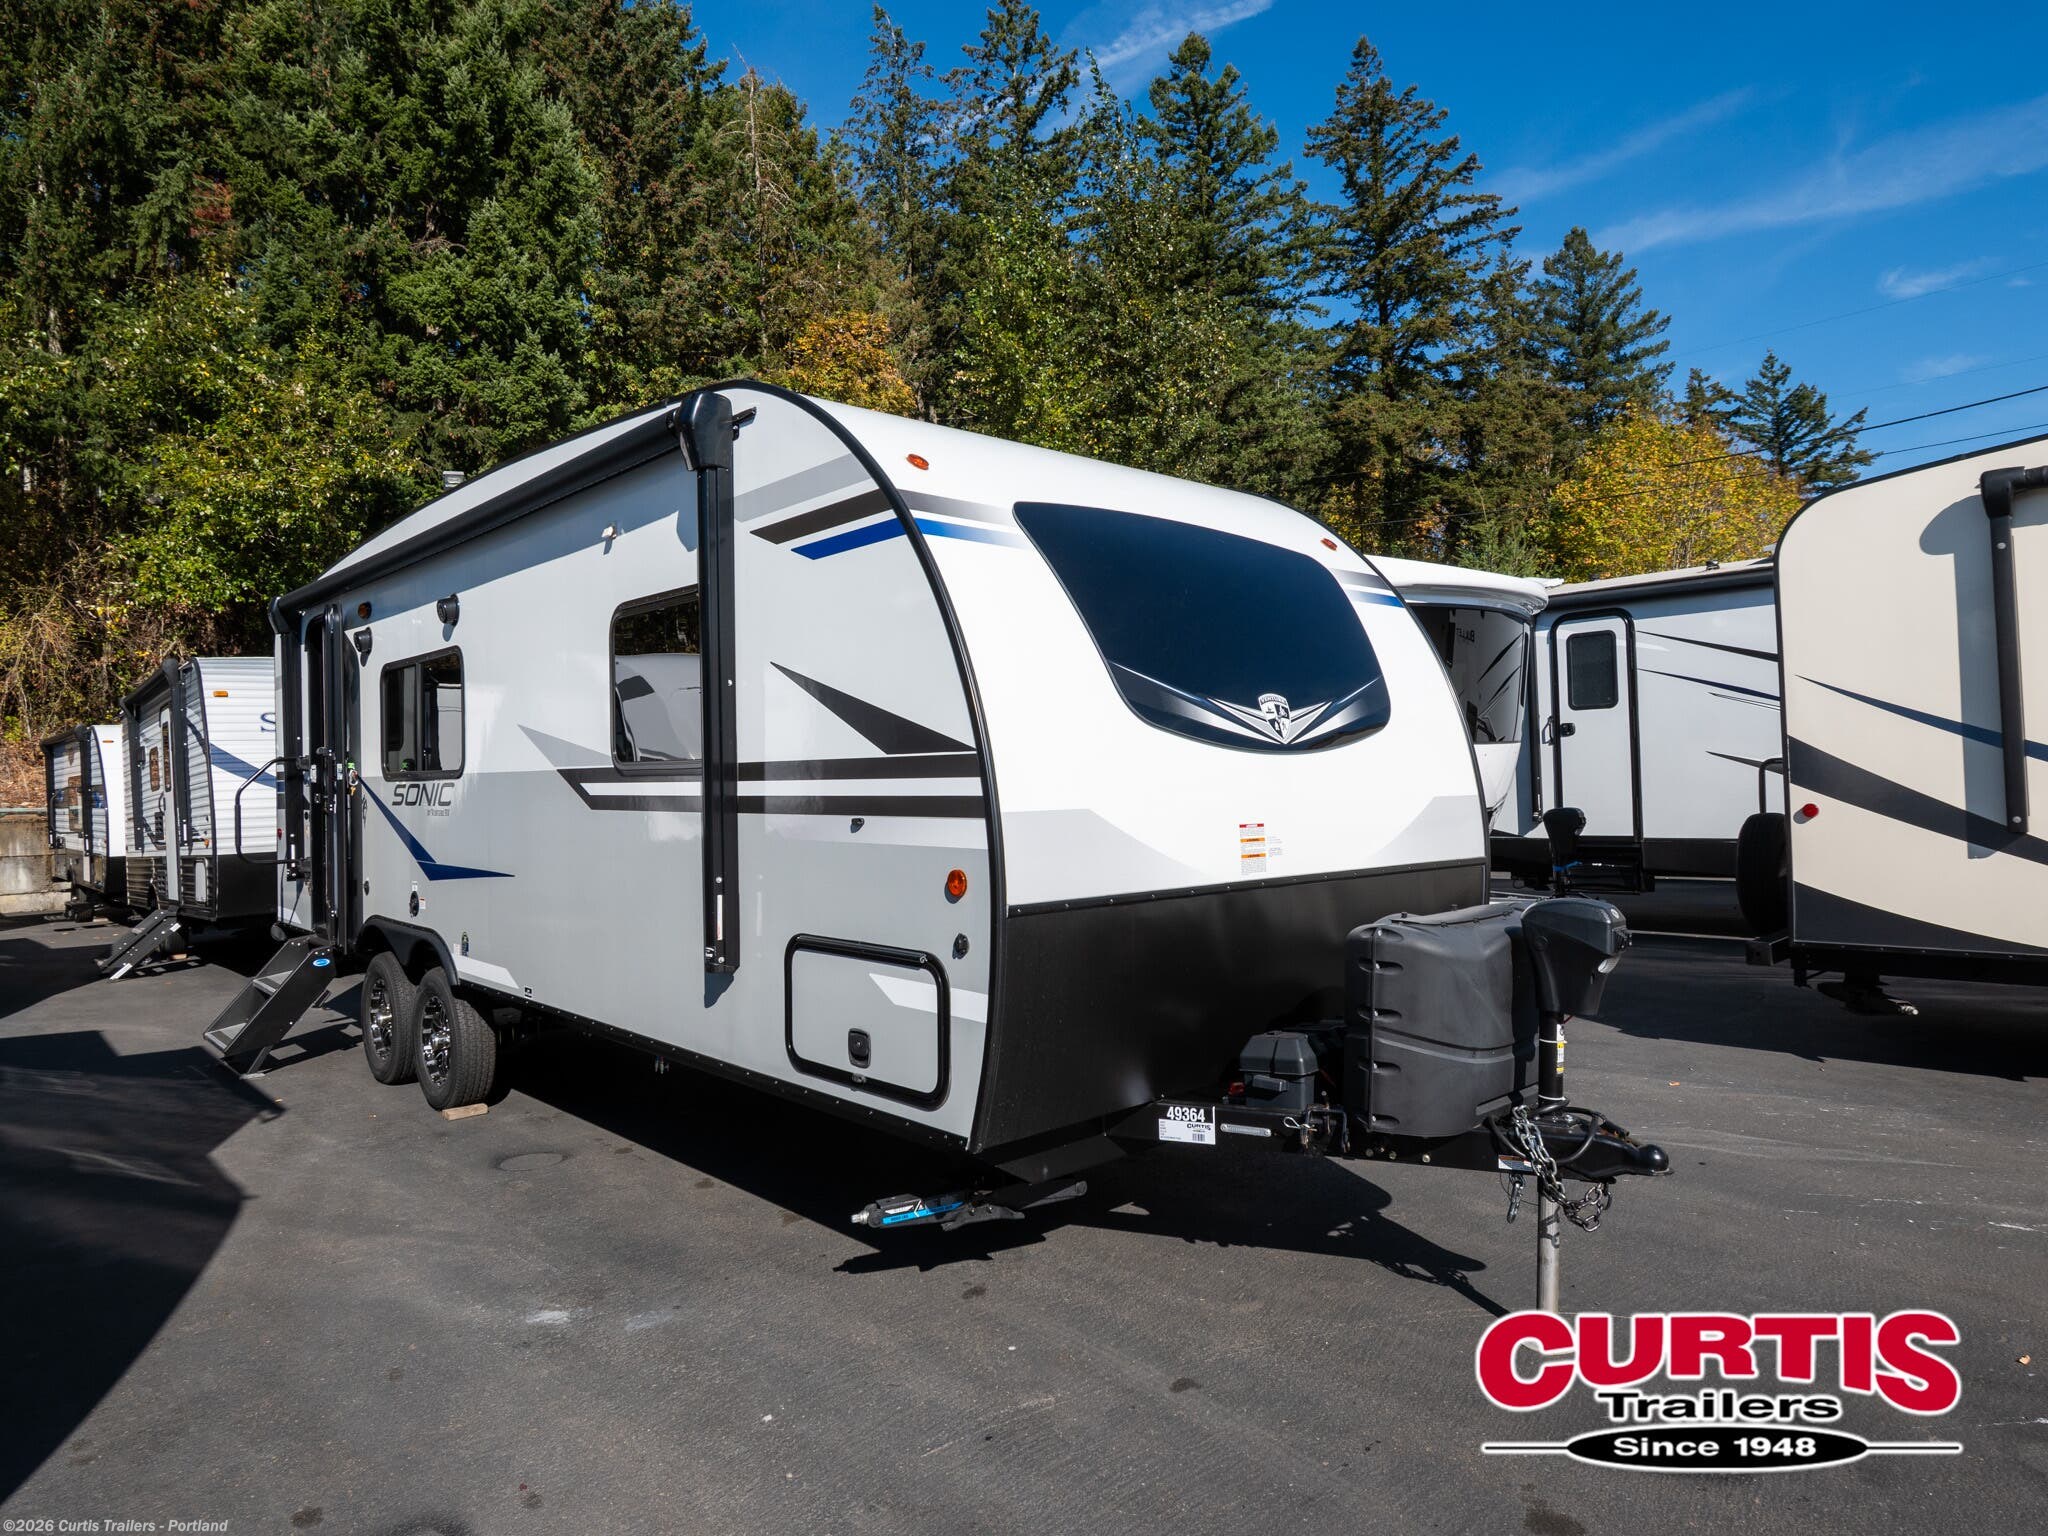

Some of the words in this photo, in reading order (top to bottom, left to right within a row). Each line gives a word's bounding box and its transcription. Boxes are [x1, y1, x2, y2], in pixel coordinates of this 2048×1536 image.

[392, 782, 455, 806] SONIC
[1166, 1106, 1205, 1122] 49364
[1187, 1123, 1211, 1131] CURTIS
